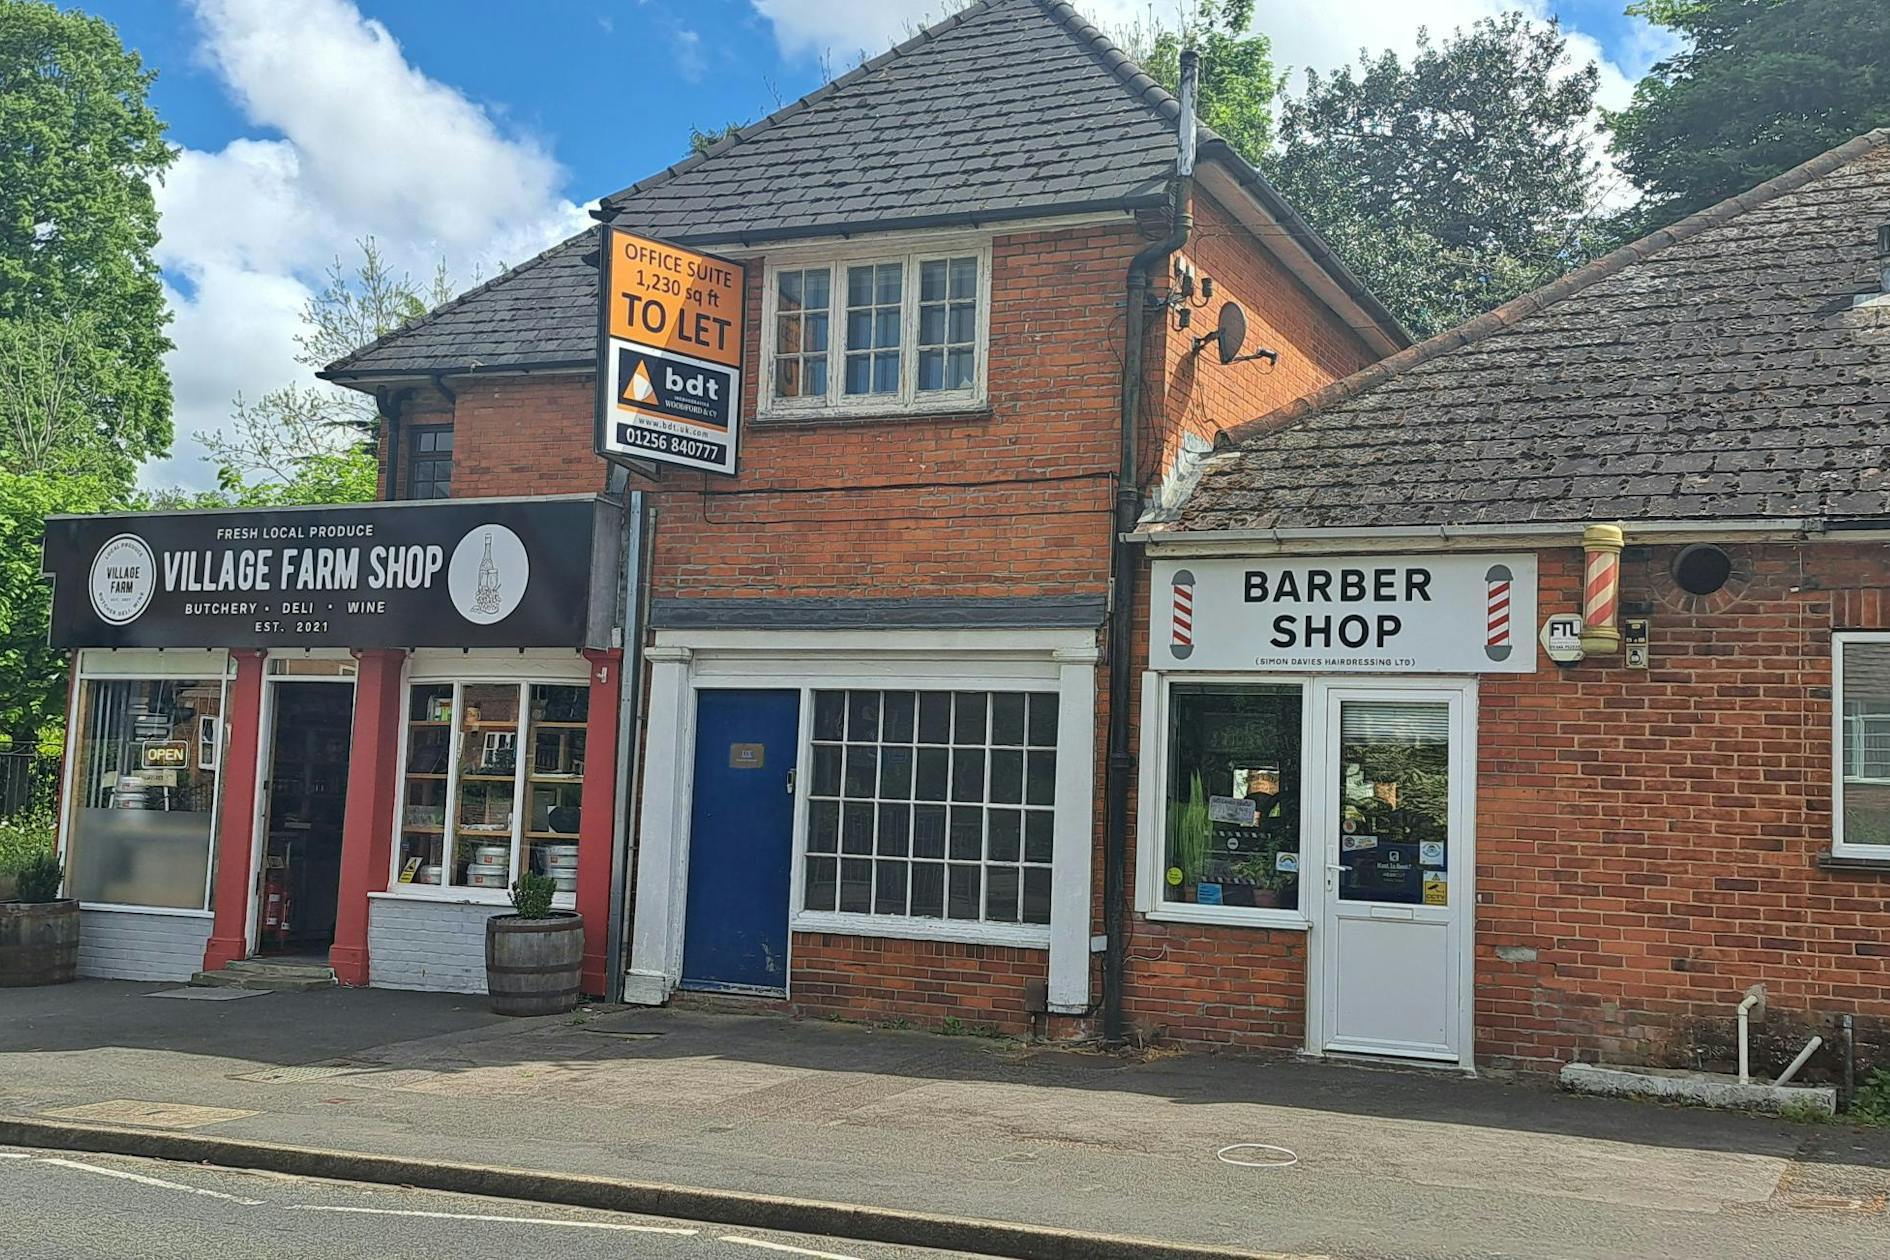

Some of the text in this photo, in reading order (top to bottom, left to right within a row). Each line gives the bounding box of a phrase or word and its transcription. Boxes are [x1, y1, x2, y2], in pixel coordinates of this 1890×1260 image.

[625, 243, 732, 289] OFFICE SUITE
[636, 269, 719, 308] 1,230 sq ft
[621, 291, 731, 350] TO LET
[665, 366, 719, 401] bdt
[638, 418, 709, 439] www.bdt.uk.com
[626, 427, 719, 461] 01256 840777
[216, 524, 374, 540] FRESH LOCAL PRODUCE
[107, 566, 141, 580] VILLAGE
[163, 544, 443, 592] VILLAGE FARM SHOP
[110, 580, 134, 594] FARM
[1244, 569, 1432, 602] BARBER
[185, 601, 386, 615] BUTCHERY DELI WINE
[255, 621, 328, 633] EST. 2021
[1270, 613, 1402, 649] SHOP
[1551, 621, 1579, 637] FTL
[1291, 658, 1322, 666] DAVIES
[1324, 657, 1392, 667] HAIRDRESSING
[1394, 658, 1416, 667] LTD)
[147, 748, 184, 761] OPEN
